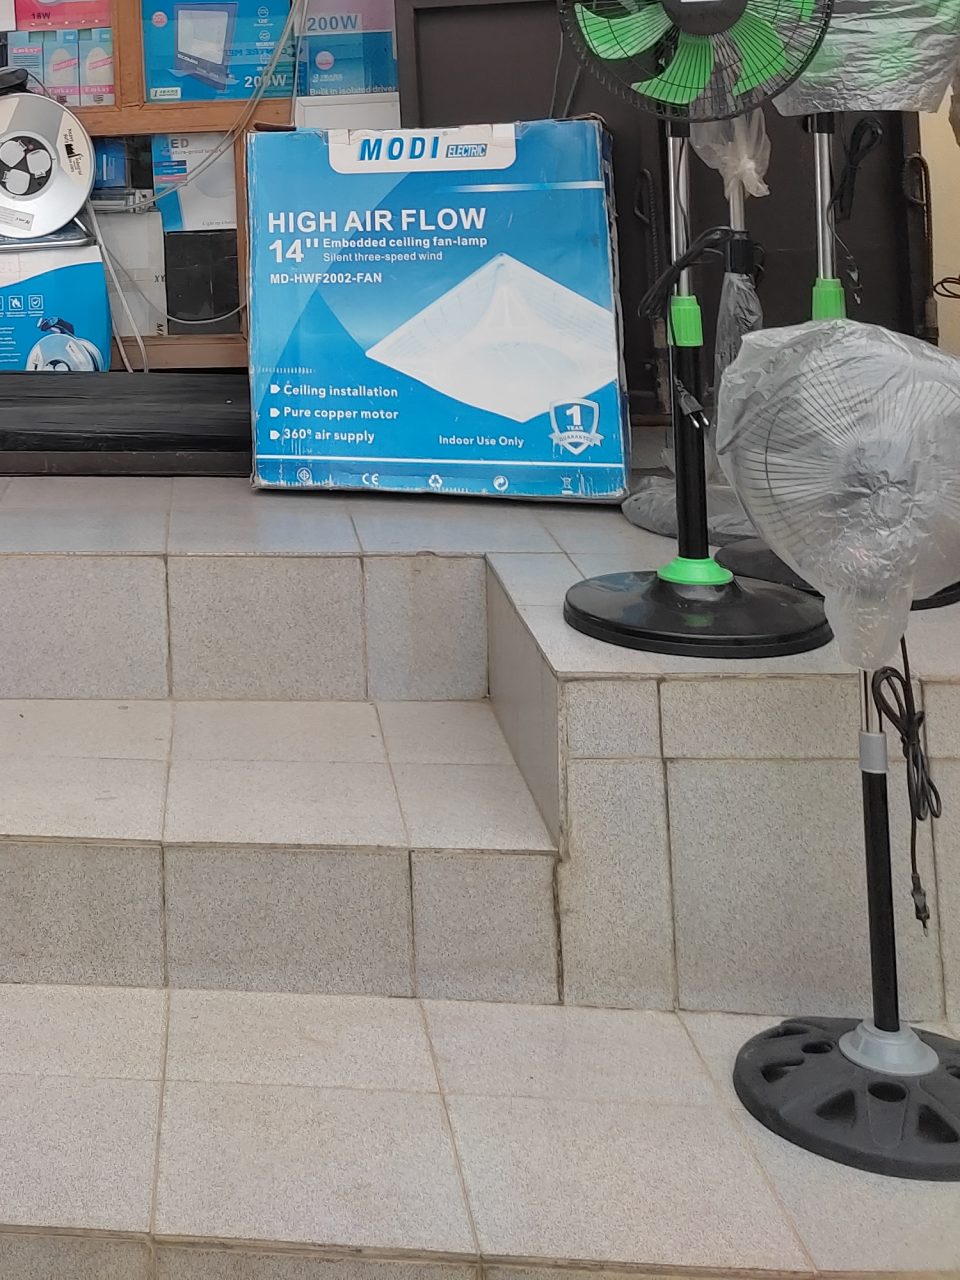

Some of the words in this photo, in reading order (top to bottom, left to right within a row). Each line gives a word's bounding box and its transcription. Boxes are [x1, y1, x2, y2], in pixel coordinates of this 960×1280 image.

[307, 14, 358, 32] 200W
[358, 135, 441, 162] MODI
[448, 143, 487, 158] ELECTRIC
[267, 210, 338, 234] HIGH
[343, 209, 395, 233] AIR
[400, 207, 487, 231] FLOW
[323, 237, 386, 249] Embedded
[389, 236, 431, 251] ceiling
[432, 236, 488, 251] fan-lamp
[323, 252, 353, 263] Silent
[354, 251, 417, 265] three-speed
[418, 251, 443, 262] wind
[269, 272, 383, 285] MD-HWF2002-FAN
[283, 384, 327, 399] Ceiling
[329, 384, 399, 398] installation
[283, 406, 312, 418] Pure
[314, 408, 358, 421] copper
[360, 409, 399, 420] motor
[565, 404, 583, 426] 1
[314, 429, 331, 441] air
[334, 429, 375, 445] supply
[439, 434, 474, 447] Indoor
[476, 435, 497, 447] Use
[499, 435, 525, 449] Only
